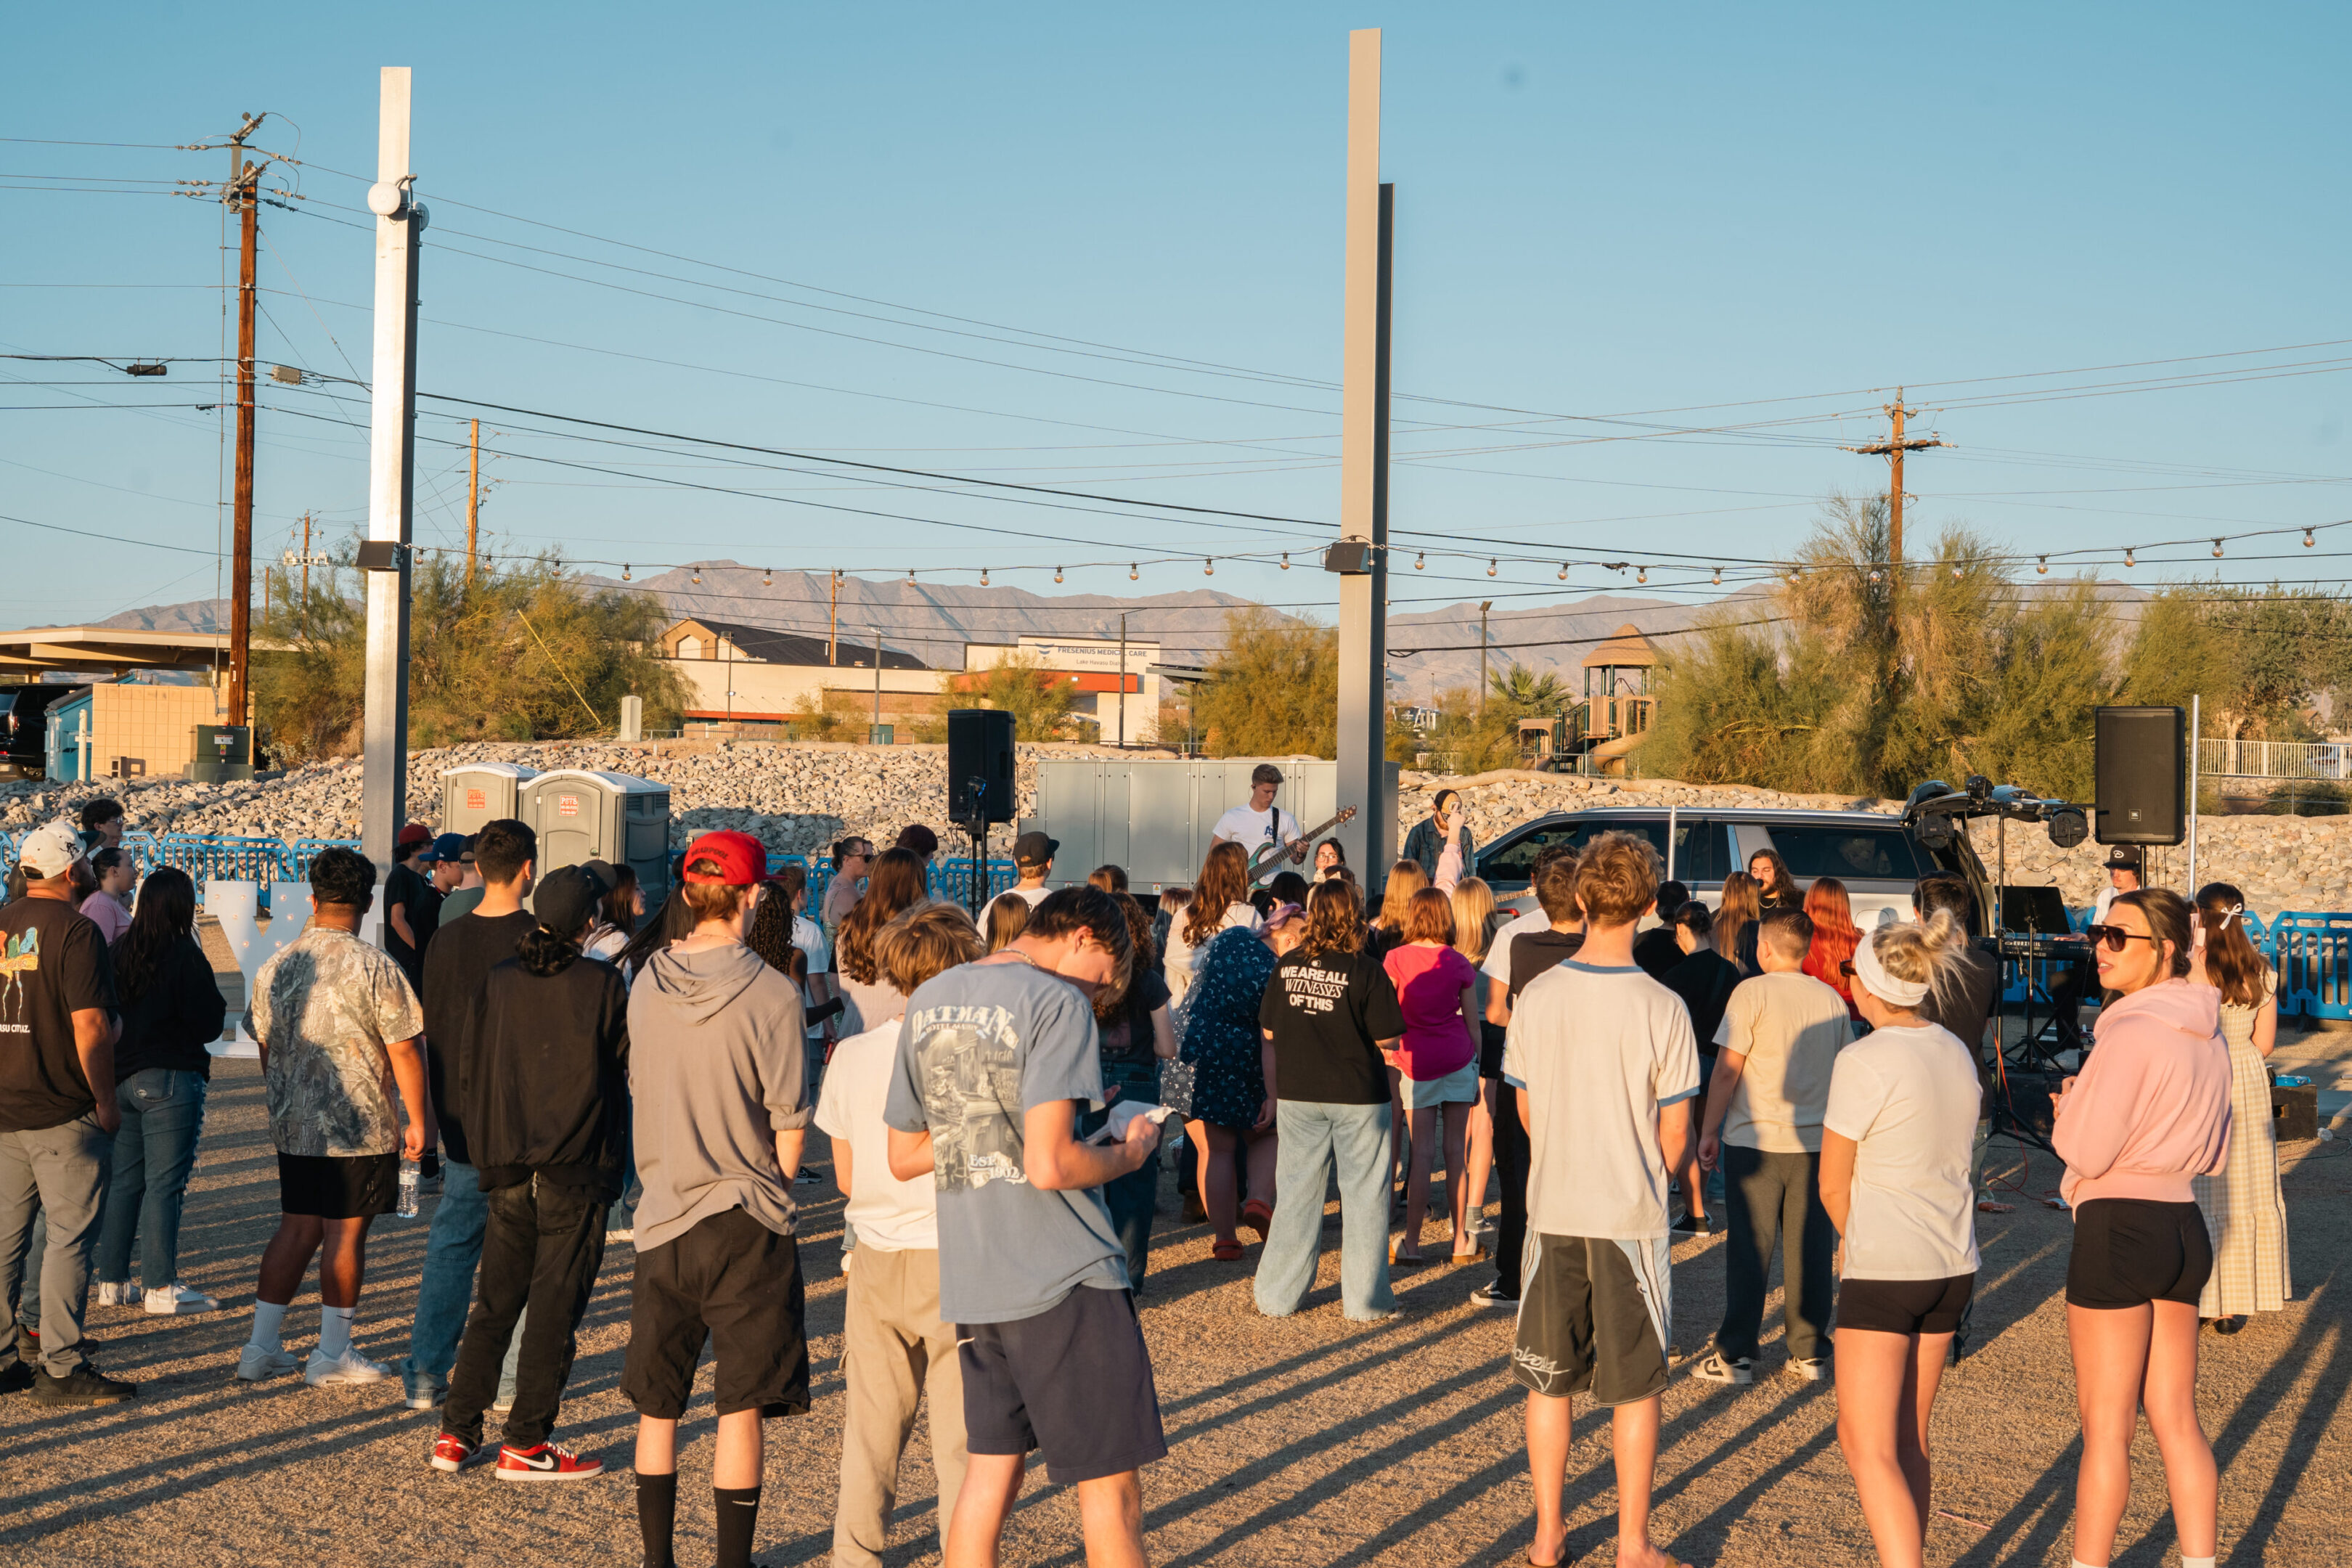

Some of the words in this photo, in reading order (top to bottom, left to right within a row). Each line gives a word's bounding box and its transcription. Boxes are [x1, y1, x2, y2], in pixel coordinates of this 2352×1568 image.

[1281, 965, 1299, 979] WE
[1297, 966, 1326, 982] ARE
[1325, 971, 1349, 986] ALL
[1285, 979, 1344, 998] WITNESSES
[1289, 993, 1304, 1006] OF
[1305, 995, 1334, 1012] THIS
[912, 1005, 1015, 1044] OATMAN
[989, 1166, 1020, 1180] 1902
